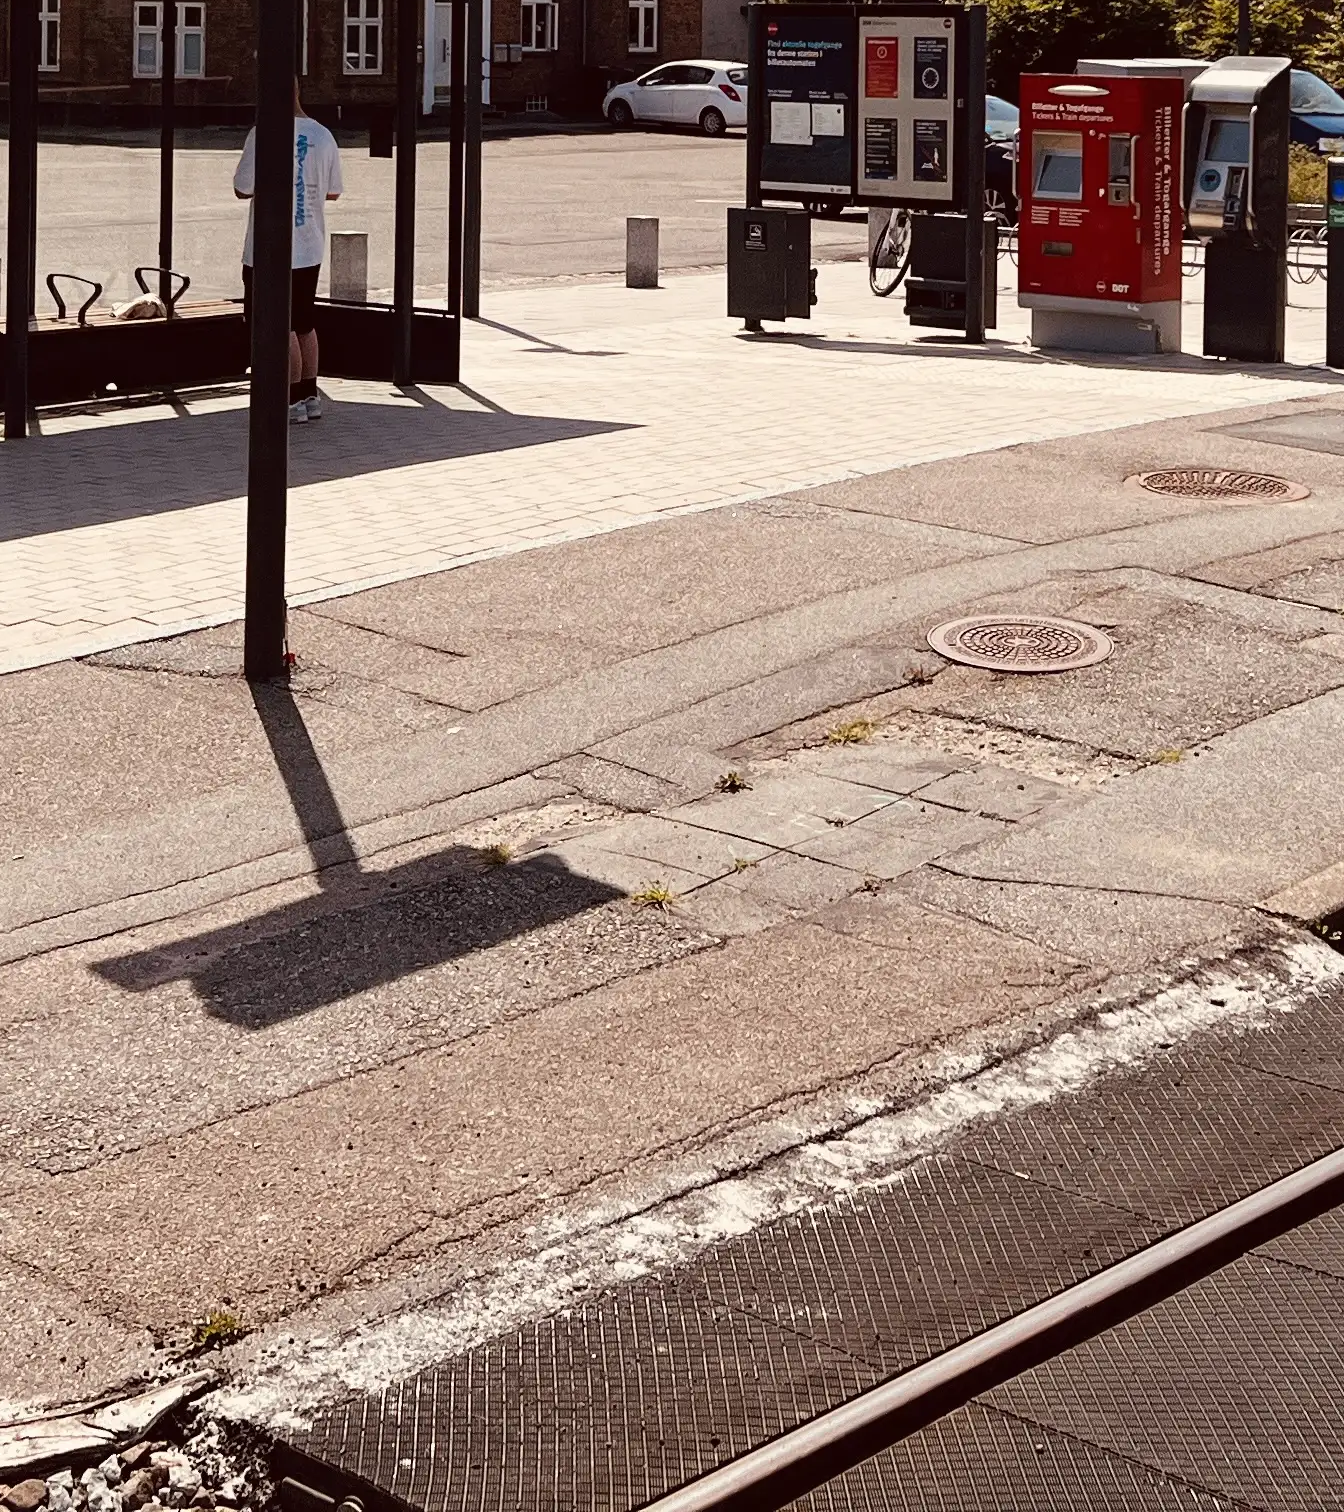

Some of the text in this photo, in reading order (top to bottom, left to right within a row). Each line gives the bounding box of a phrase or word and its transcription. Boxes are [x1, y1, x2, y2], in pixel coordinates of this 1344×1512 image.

[1032, 102, 1058, 111] Billetter
[1065, 104, 1104, 113] Togafgange
[1032, 111, 1054, 120] Tickets
[1061, 112, 1077, 121] Train
[1078, 114, 1114, 122] departures
[1152, 107, 1163, 275] Tickets & Train departures
[1162, 106, 1172, 256] Billetter & Togafgange
